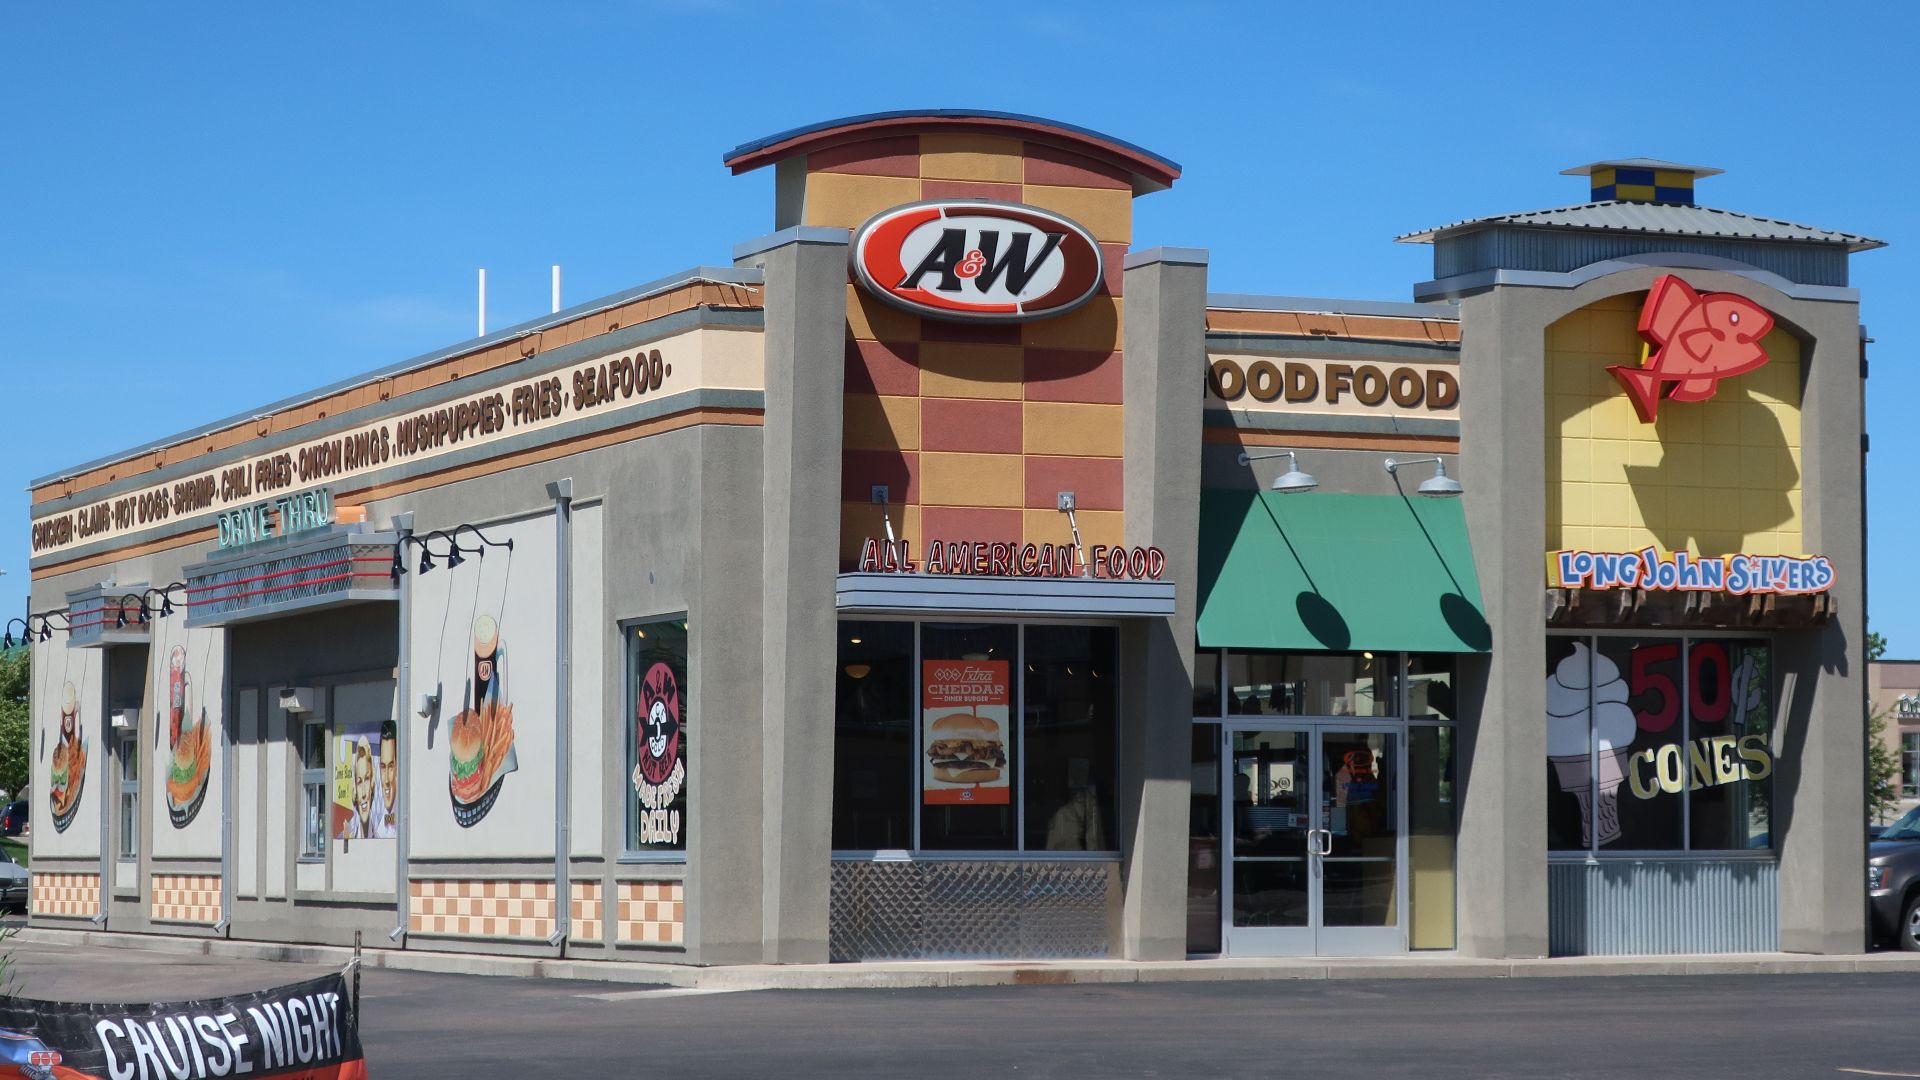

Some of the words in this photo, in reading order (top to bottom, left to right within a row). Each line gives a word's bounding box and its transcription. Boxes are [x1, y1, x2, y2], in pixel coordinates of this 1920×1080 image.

[894, 228, 1068, 296] A&W
[1203, 358, 1319, 405] OOD
[1325, 364, 1459, 411] FOOD
[32, 514, 73, 552] CHICKEN
[78, 501, 111, 539] CLAMS
[115, 497, 136, 531] HOT
[138, 487, 169, 523] DOGS
[173, 474, 216, 515] SHRIMP
[221, 463, 252, 502] CHILI
[255, 452, 292, 493] FRIES
[299, 439, 342, 483] ONION
[344, 426, 390, 471] RINGS
[397, 392, 504, 456] HUSHPUPPIES
[512, 376, 562, 426] FRIES
[572, 349, 664, 411] SEAFOOD
[218, 503, 271, 549] DRIVE
[276, 487, 329, 534] THRU
[862, 538, 915, 573] ALL
[928, 540, 1075, 577] AMERICAN
[1093, 545, 1166, 579] FOOD
[928, 684, 1004, 695] CHEDDAR
[960, 666, 994, 682] Extra
[651, 738, 665, 753] COLD
[1629, 733, 1772, 800] CONES
[632, 763, 657, 809] MADE
[657, 757, 685, 809] FRESH
[640, 809, 680, 845] DAILY
[96, 1012, 253, 1080] CRUISE
[247, 992, 341, 1069] NIGHT
